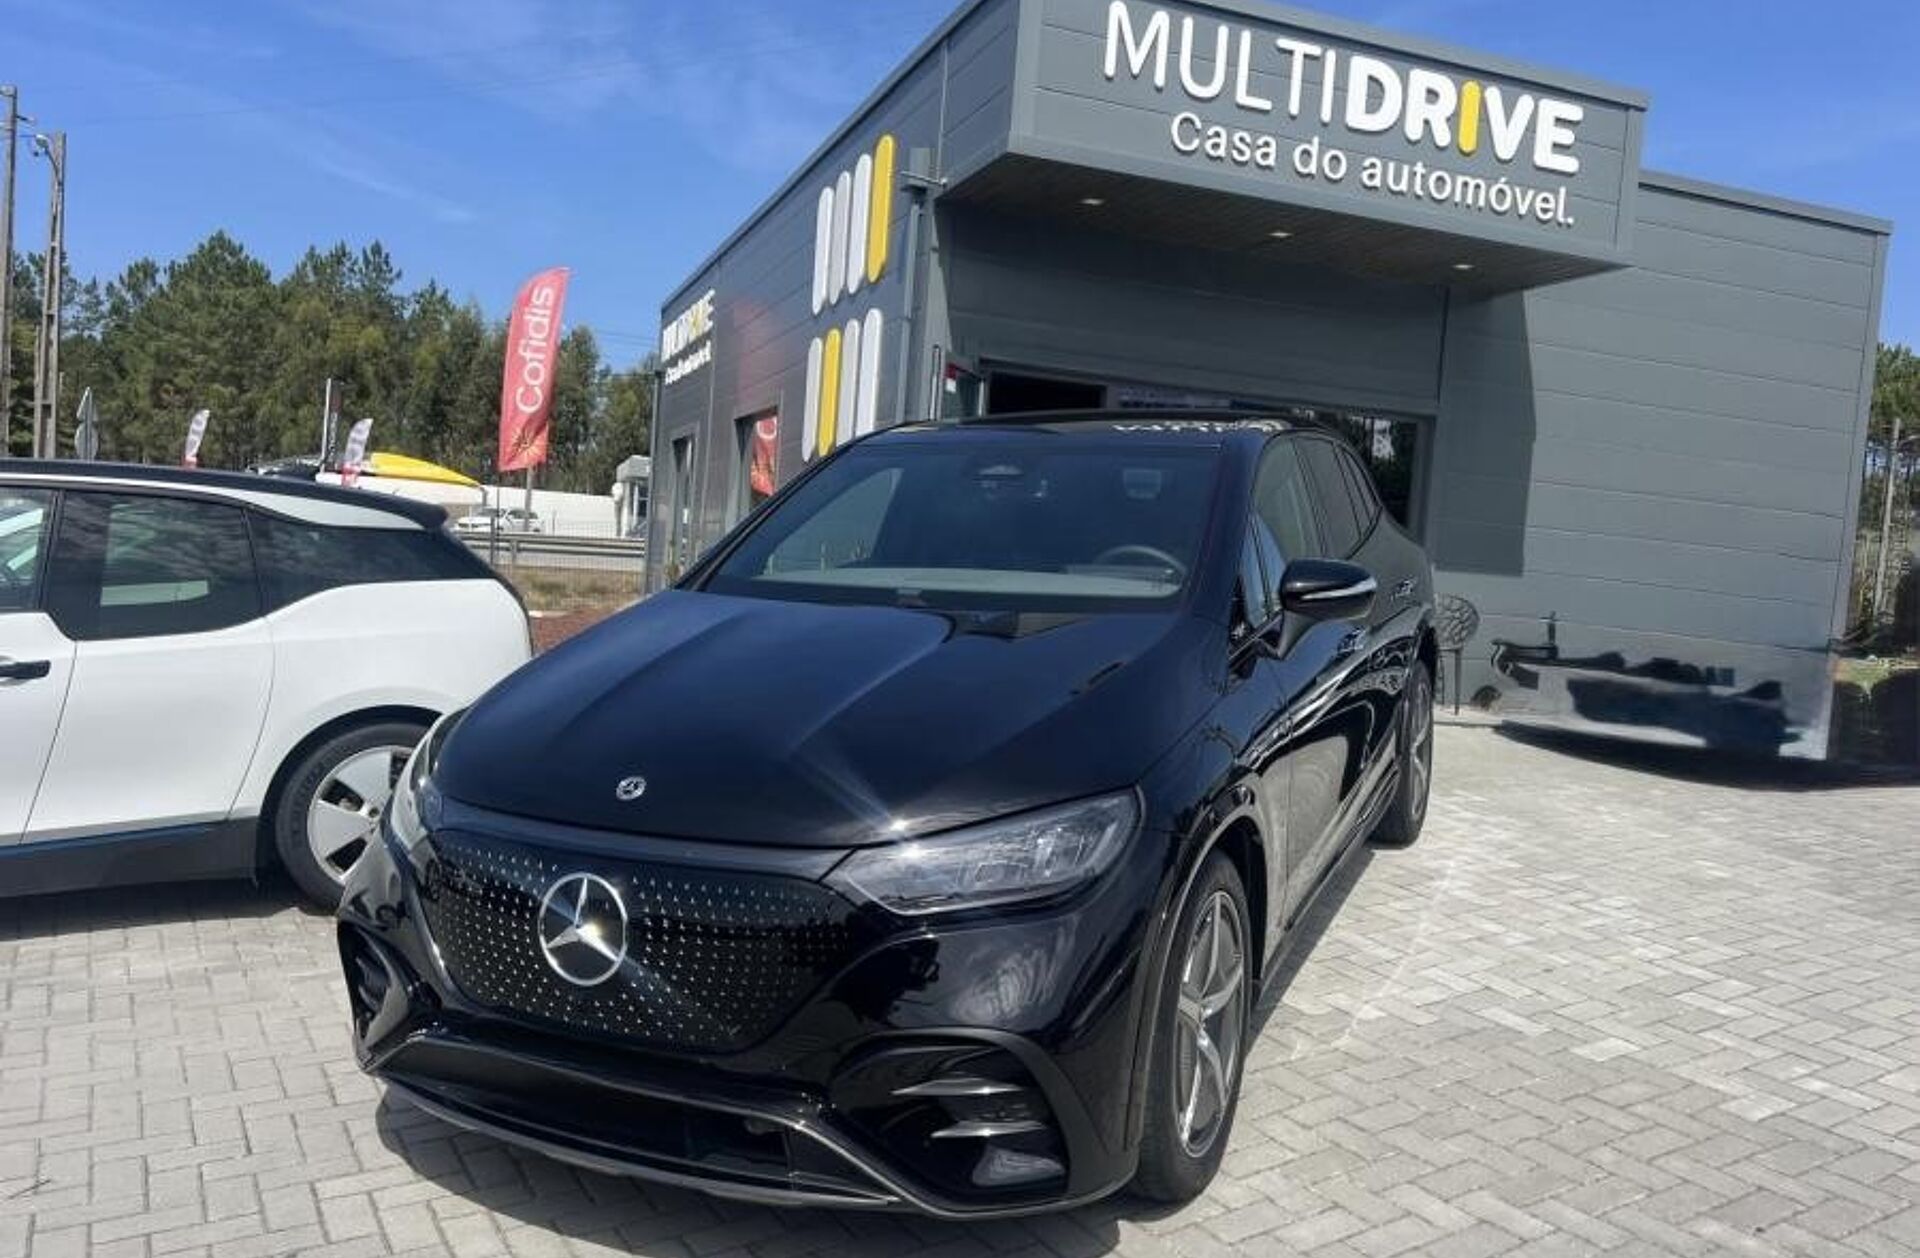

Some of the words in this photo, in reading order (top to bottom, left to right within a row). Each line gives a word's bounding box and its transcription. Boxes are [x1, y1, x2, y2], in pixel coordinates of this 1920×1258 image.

[1104, 0, 1584, 174] MULTIDRIVE
[1170, 111, 1277, 168] Casa
[1292, 136, 1348, 180] do
[1360, 157, 1575, 226] automóvel.
[514, 286, 556, 414] Cofidis
